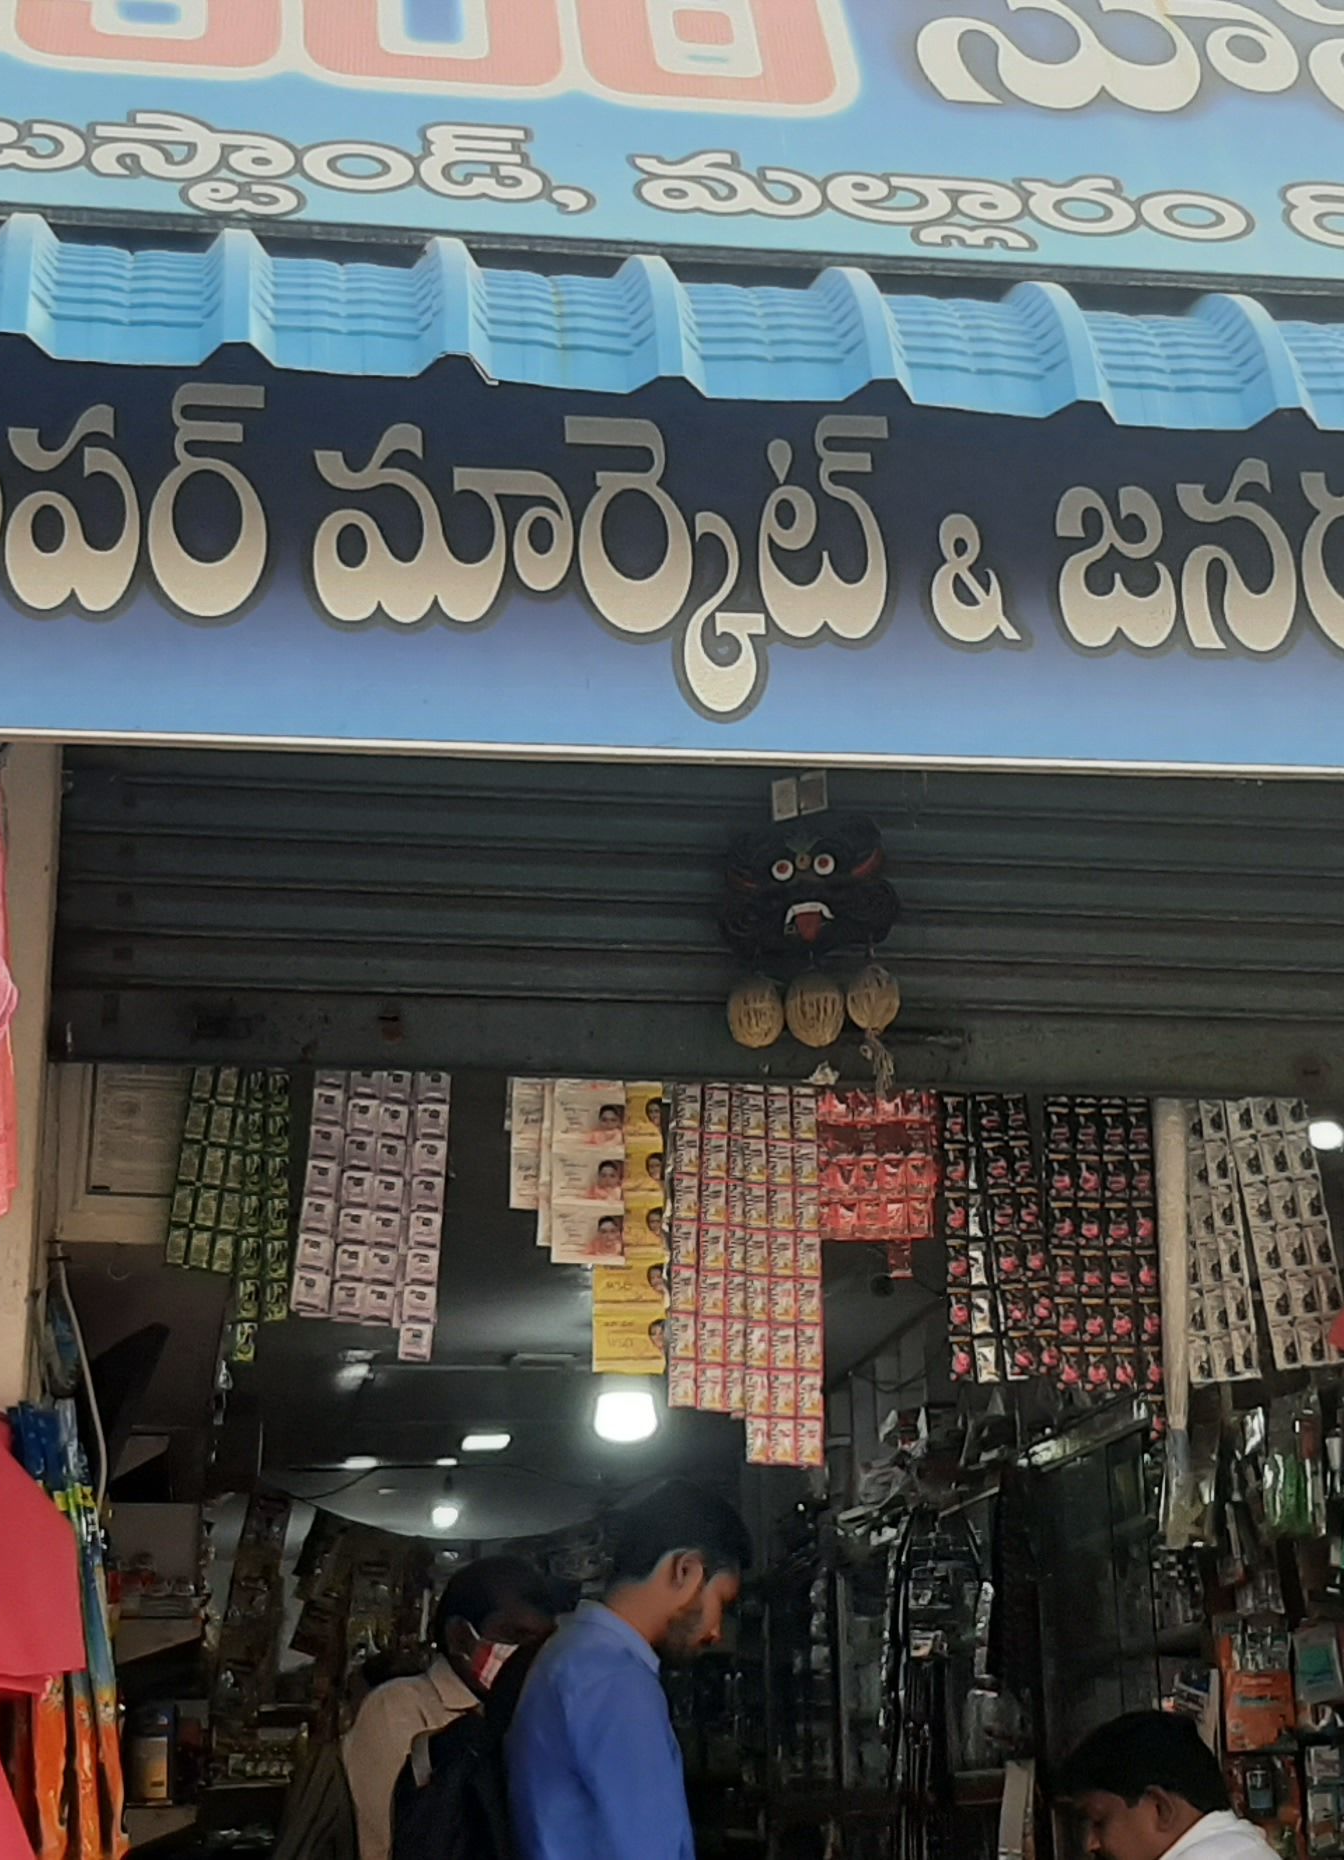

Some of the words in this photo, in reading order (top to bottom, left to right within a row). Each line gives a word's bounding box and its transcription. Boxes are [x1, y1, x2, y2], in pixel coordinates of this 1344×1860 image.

[631, 152, 1256, 252] మల్లారం
[312, 414, 889, 714] మార్కెట్
[929, 511, 1023, 645] &
